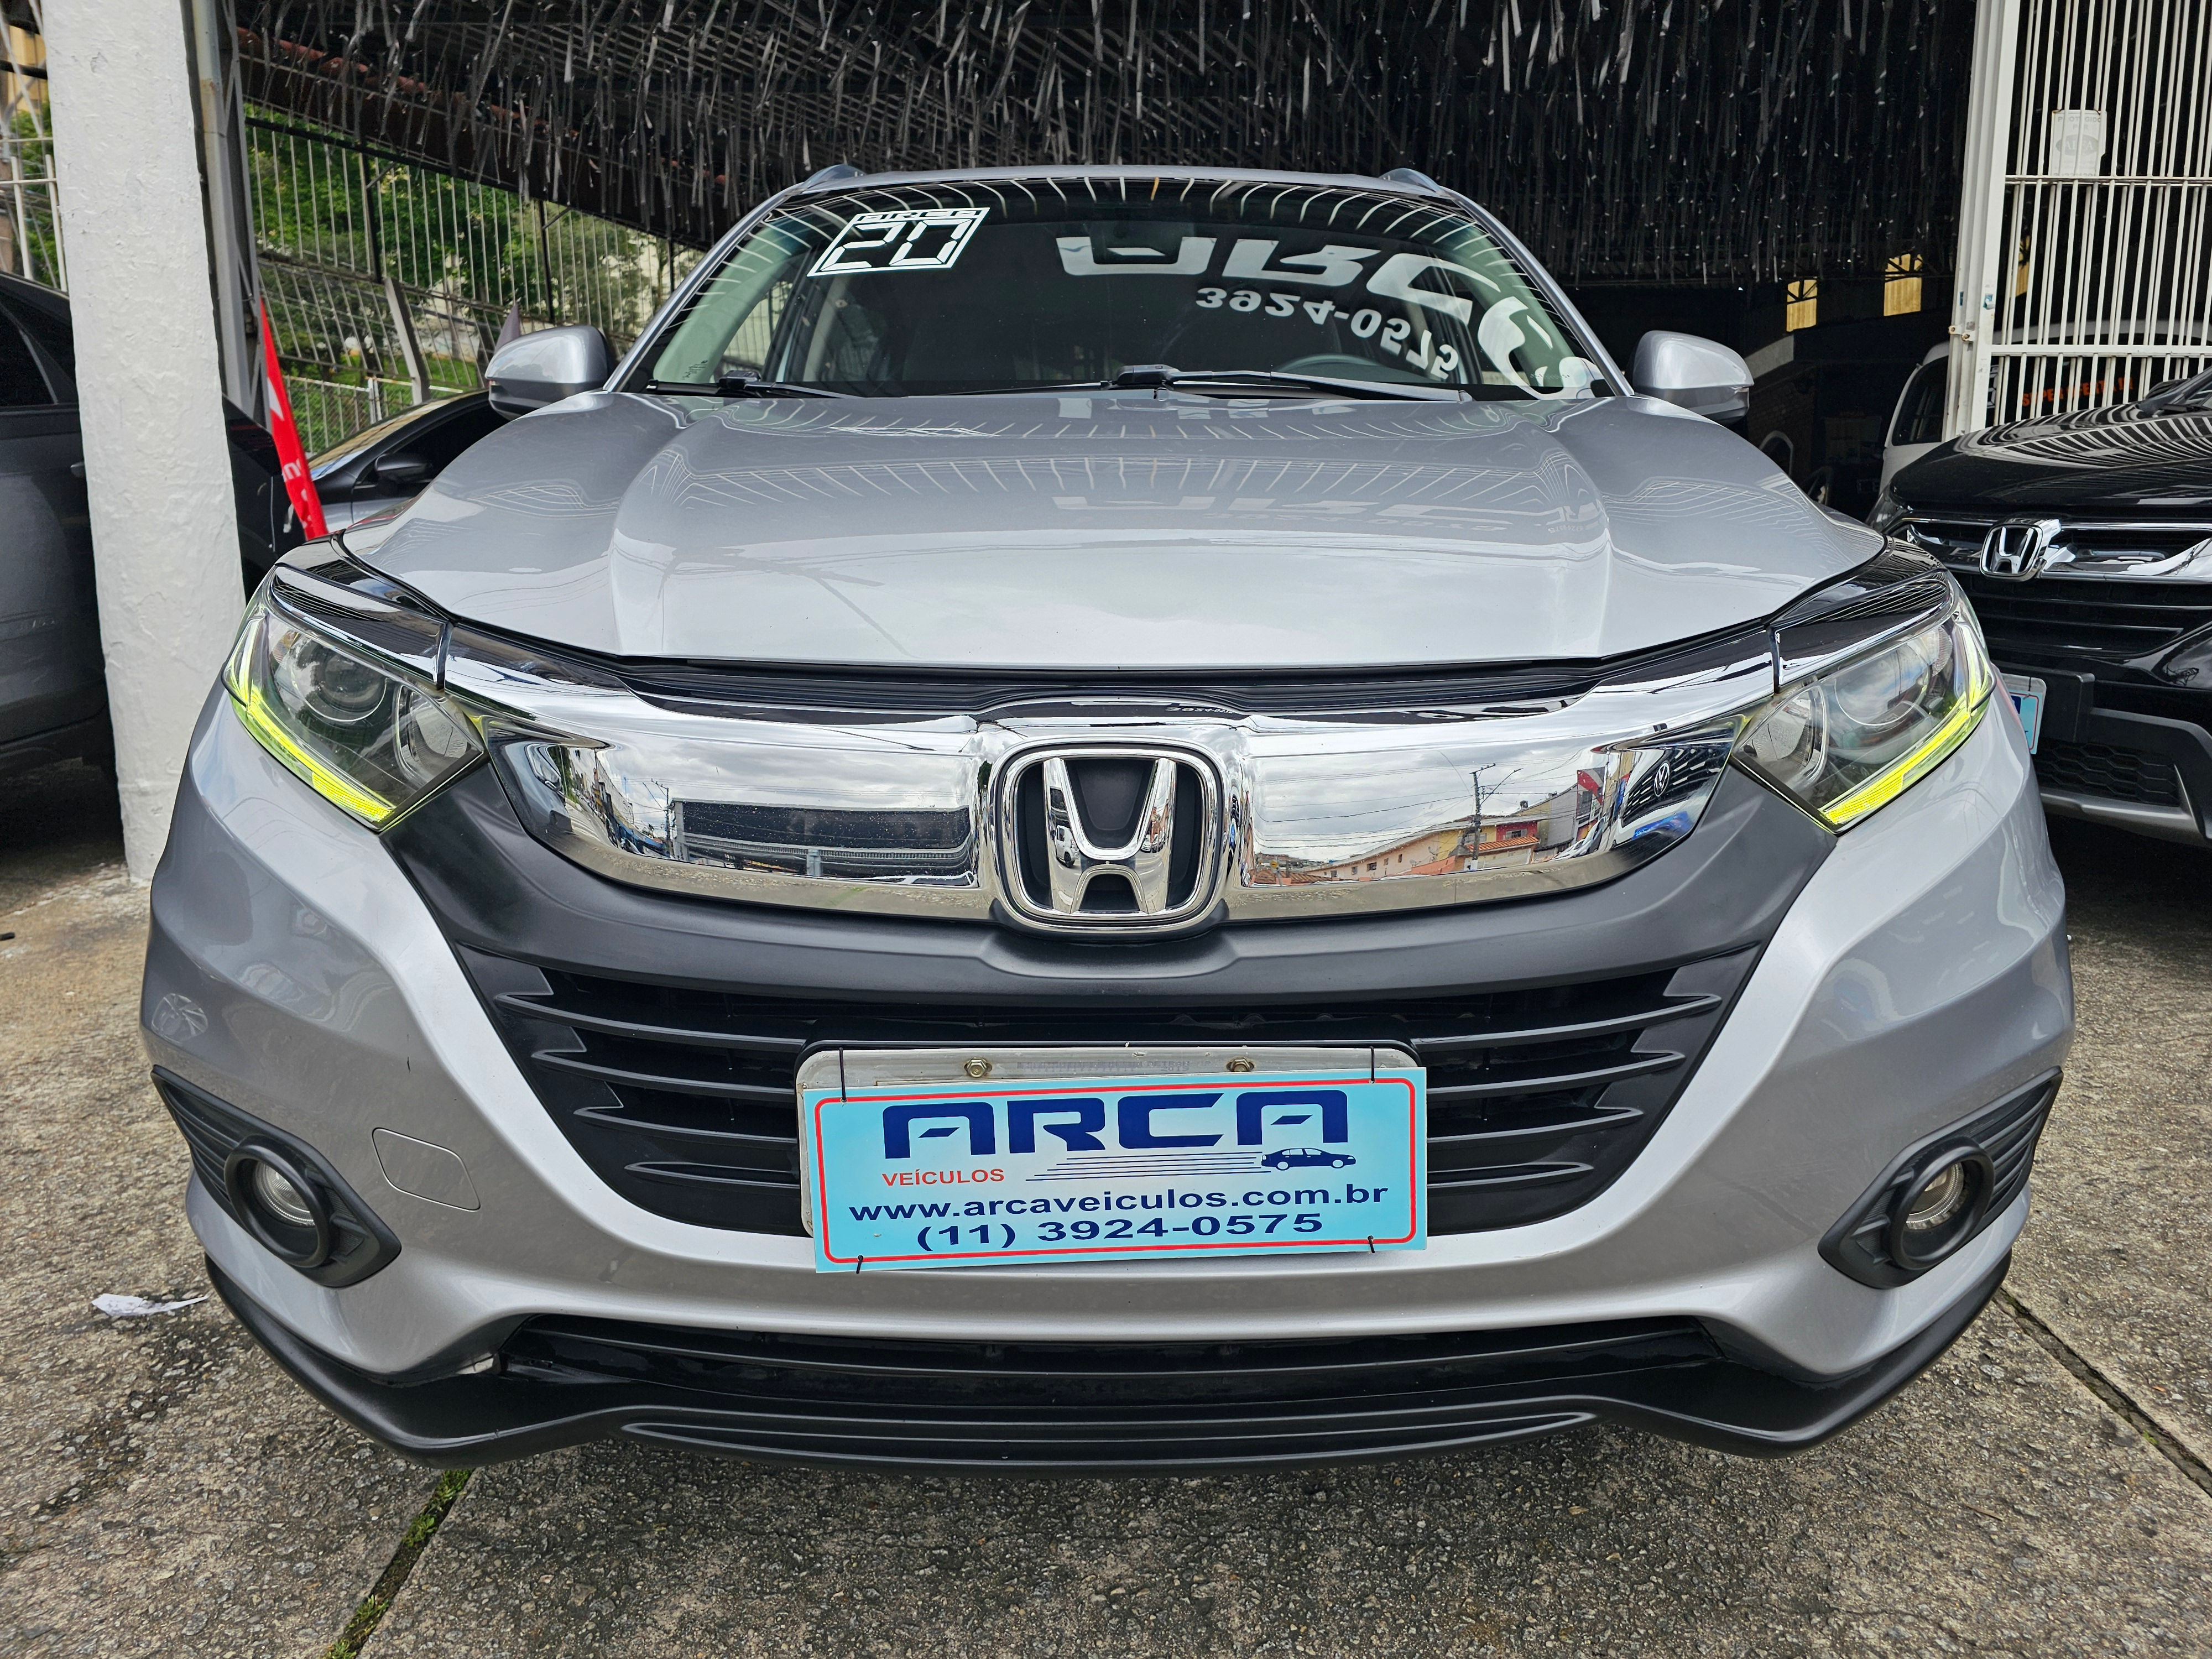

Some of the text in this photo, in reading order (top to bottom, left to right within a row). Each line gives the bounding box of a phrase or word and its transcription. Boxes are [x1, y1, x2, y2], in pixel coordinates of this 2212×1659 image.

[857, 209, 979, 222] ARCA
[821, 219, 973, 272] 20
[883, 1090, 1348, 1159] ARCA
[881, 1167, 1005, 1187] VEÍCULOS
[849, 1183, 1389, 1221] www.arcaveiculos.com.br
[917, 1213, 1323, 1251] (11) 3924-0575
